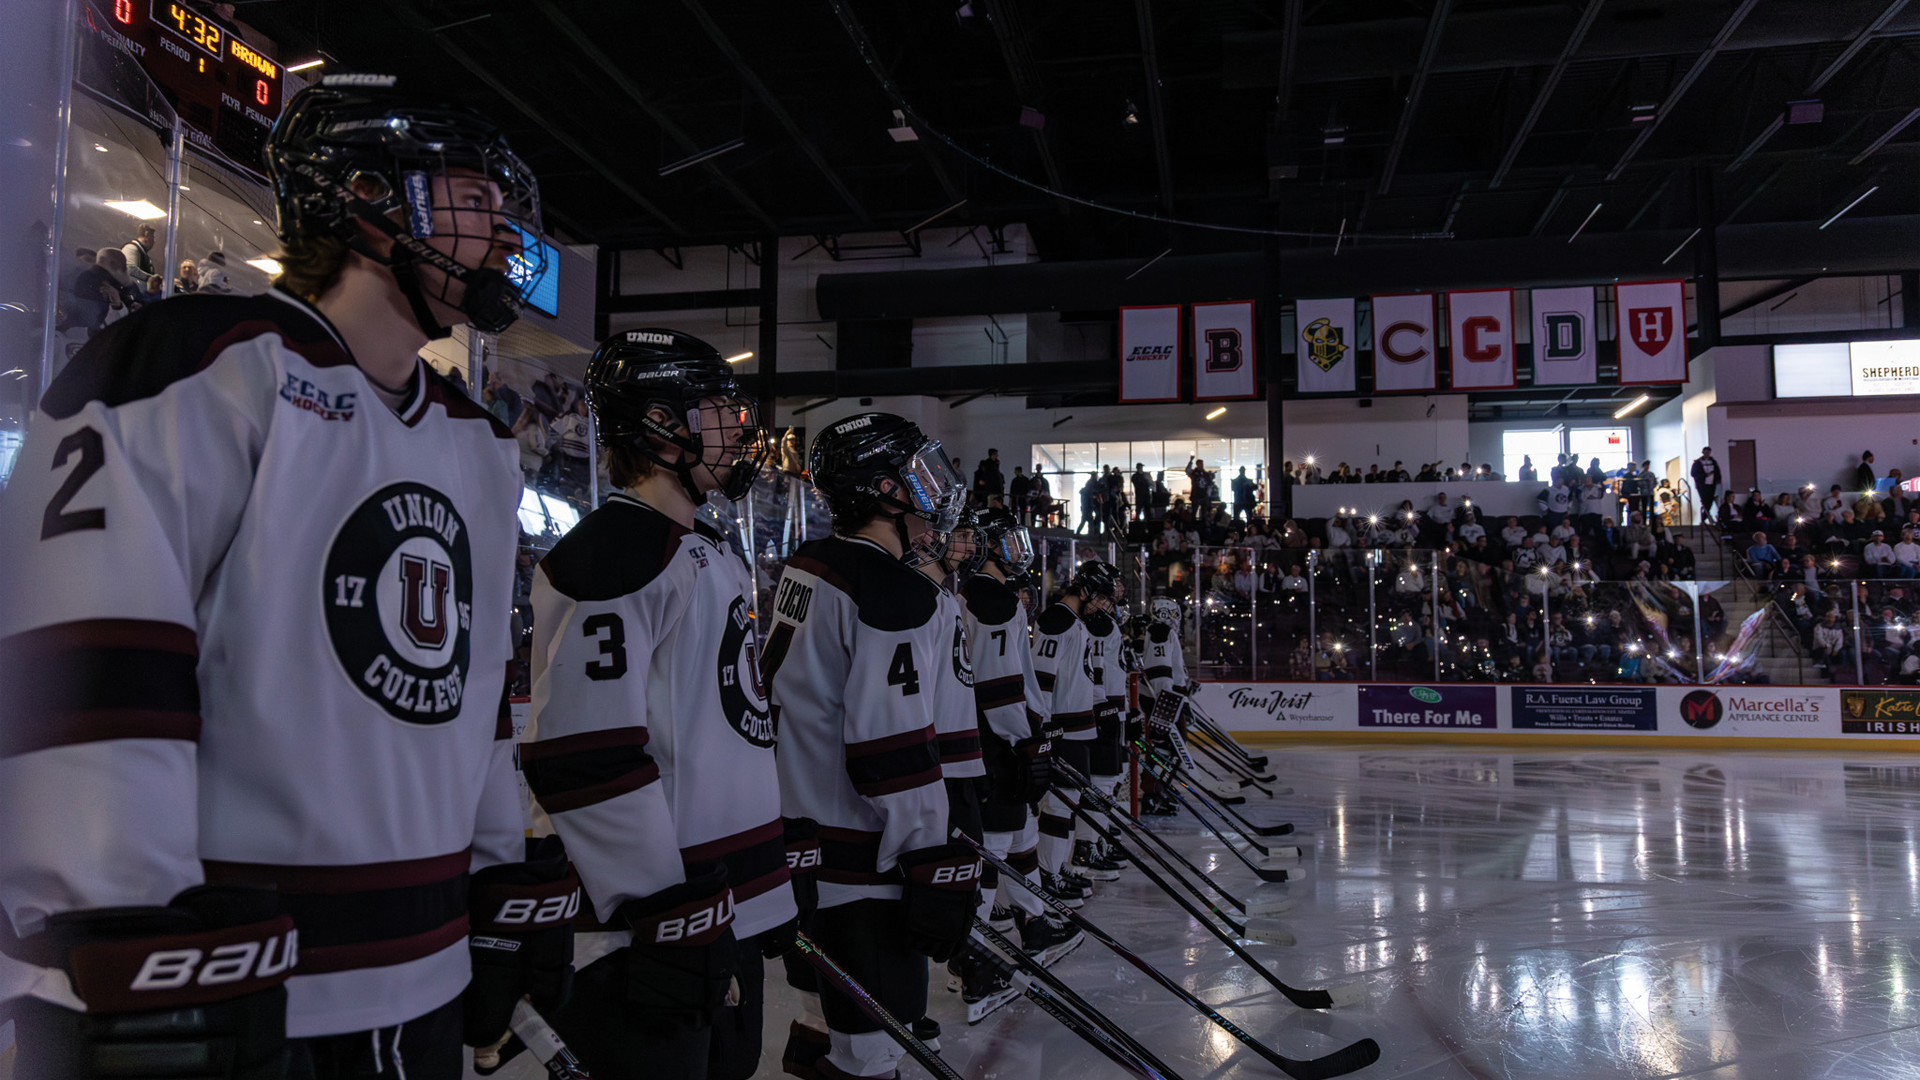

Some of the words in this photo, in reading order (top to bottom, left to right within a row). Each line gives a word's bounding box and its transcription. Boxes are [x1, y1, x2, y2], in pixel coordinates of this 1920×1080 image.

[171, 4, 220, 53] 4:32
[159, 36, 191, 63] PERIOD
[231, 40, 276, 80] BROWN
[199, 58, 206, 73] 1
[221, 92, 241, 111] PLYR
[256, 79, 269, 105] 0
[626, 332, 675, 346] UNION
[1462, 316, 1501, 362] C
[1543, 311, 1585, 361] D
[1637, 311, 1665, 343] H
[1132, 345, 1174, 355] ECAC
[1205, 328, 1242, 372] B
[1380, 320, 1430, 365] C
[637, 370, 680, 380] BAUER
[1862, 366, 1920, 378] SHEPHERD
[284, 372, 358, 410] ECAC
[292, 396, 355, 421] HOCKEY
[641, 417, 674, 439] BAUER
[834, 417, 873, 435] UNION
[40, 426, 106, 541] 2
[908, 474, 934, 511] BAUER
[382, 493, 460, 547] UNION
[334, 573, 367, 608] 17
[400, 553, 450, 650] U
[583, 614, 627, 680] 3
[991, 629, 1006, 657] 7
[1038, 638, 1058, 658] 10
[1093, 640, 1104, 656] 11
[1154, 646, 1166, 657] 31
[722, 664, 735, 687] 17
[887, 642, 920, 696] 4
[364, 653, 463, 713] COLLEGE
[1229, 687, 1268, 709] Trus
[1267, 690, 1314, 714] Joist
[1526, 694, 1549, 704] R.A.
[1551, 694, 1582, 704] Fuerst
[1585, 695, 1606, 704] Law
[1609, 695, 1642, 706] Group
[1729, 697, 1819, 712] Marcella's
[1875, 697, 1914, 718] Katie
[1289, 713, 1334, 722] Weyerhaeuser
[1372, 709, 1420, 725] There
[1424, 710, 1451, 725] For
[1455, 710, 1482, 725] Me
[1728, 713, 1780, 721] APPLIANCE
[1783, 714, 1819, 722] CENTER
[1867, 722, 1919, 733] IRISH
[1170, 732, 1195, 770] BAUER
[1030, 883, 1073, 916] BAUER
[1034, 996, 1077, 1030] BAUER
[1209, 1011, 1251, 1042] FLYLITE
